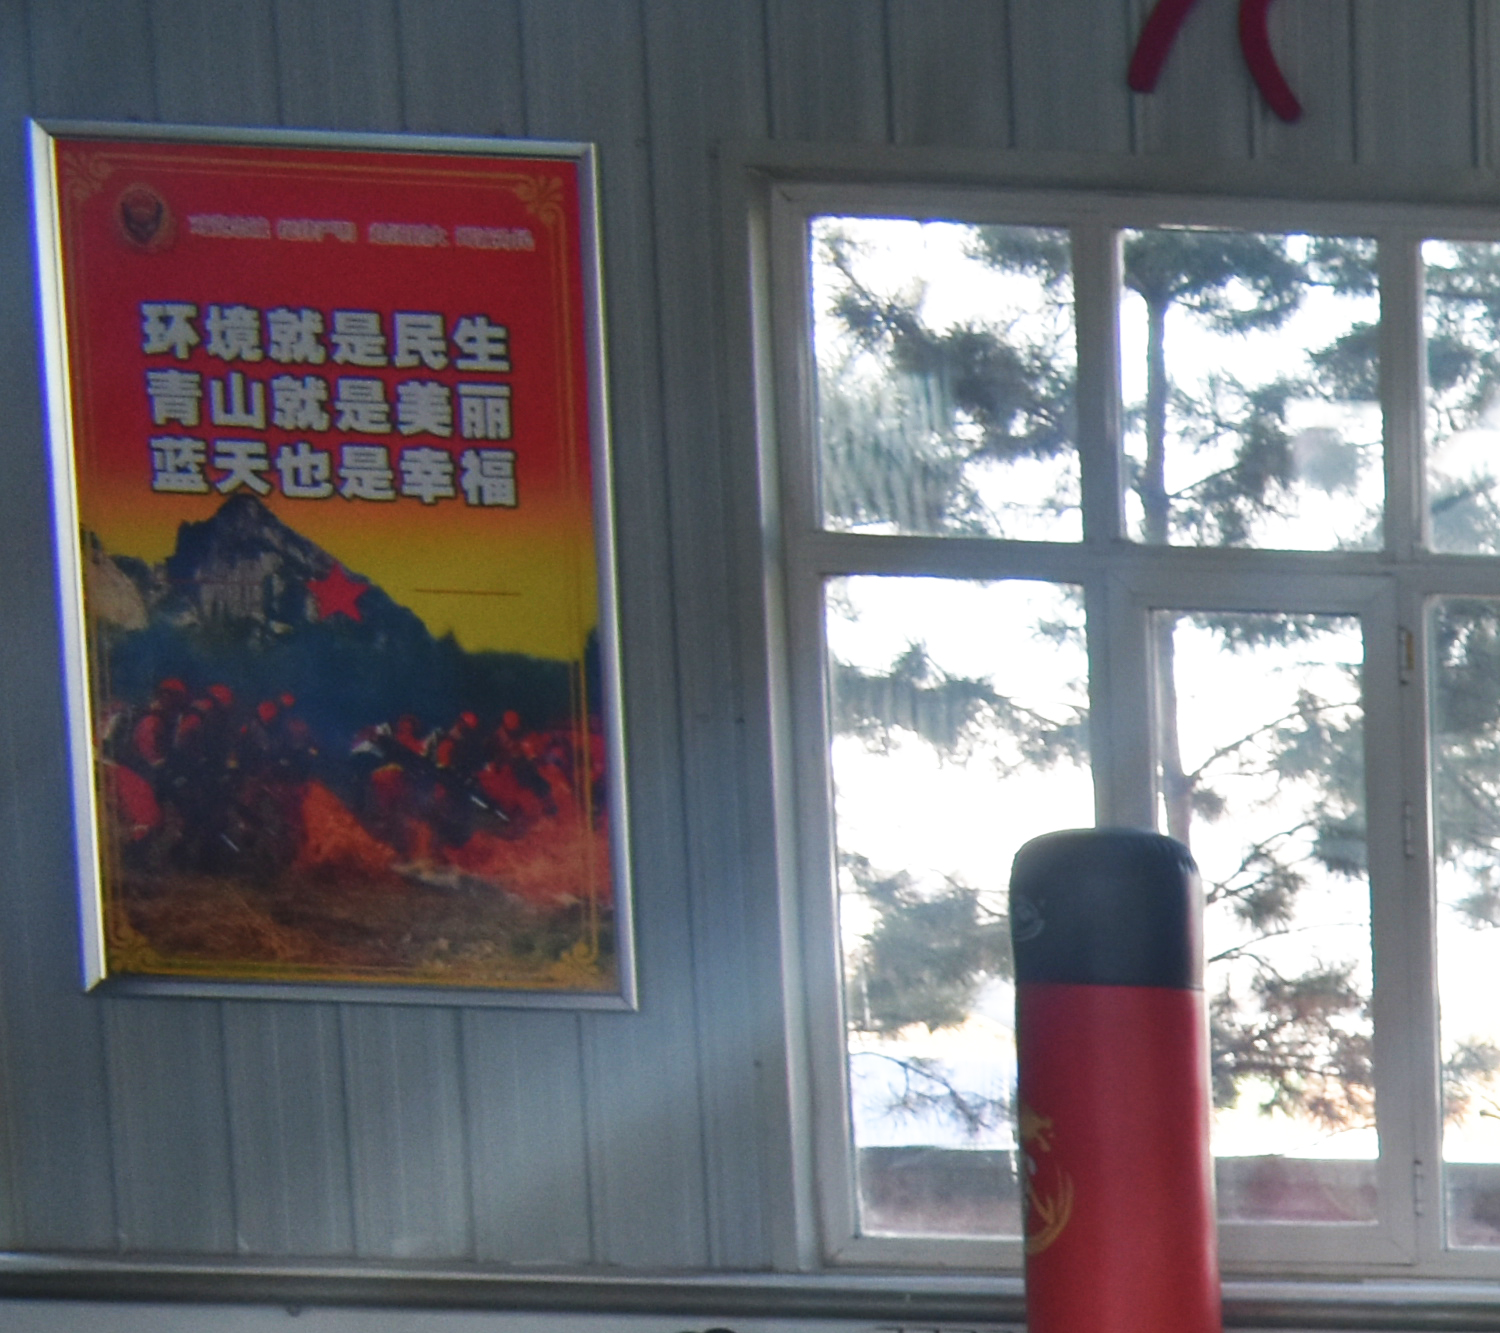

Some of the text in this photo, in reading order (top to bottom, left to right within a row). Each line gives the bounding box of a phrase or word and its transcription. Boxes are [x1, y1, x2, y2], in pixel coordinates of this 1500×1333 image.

[141, 302, 510, 372] 环境就是民生
[147, 370, 512, 439] 青山就是美丽
[151, 437, 517, 506] 蓝天也是幸福
